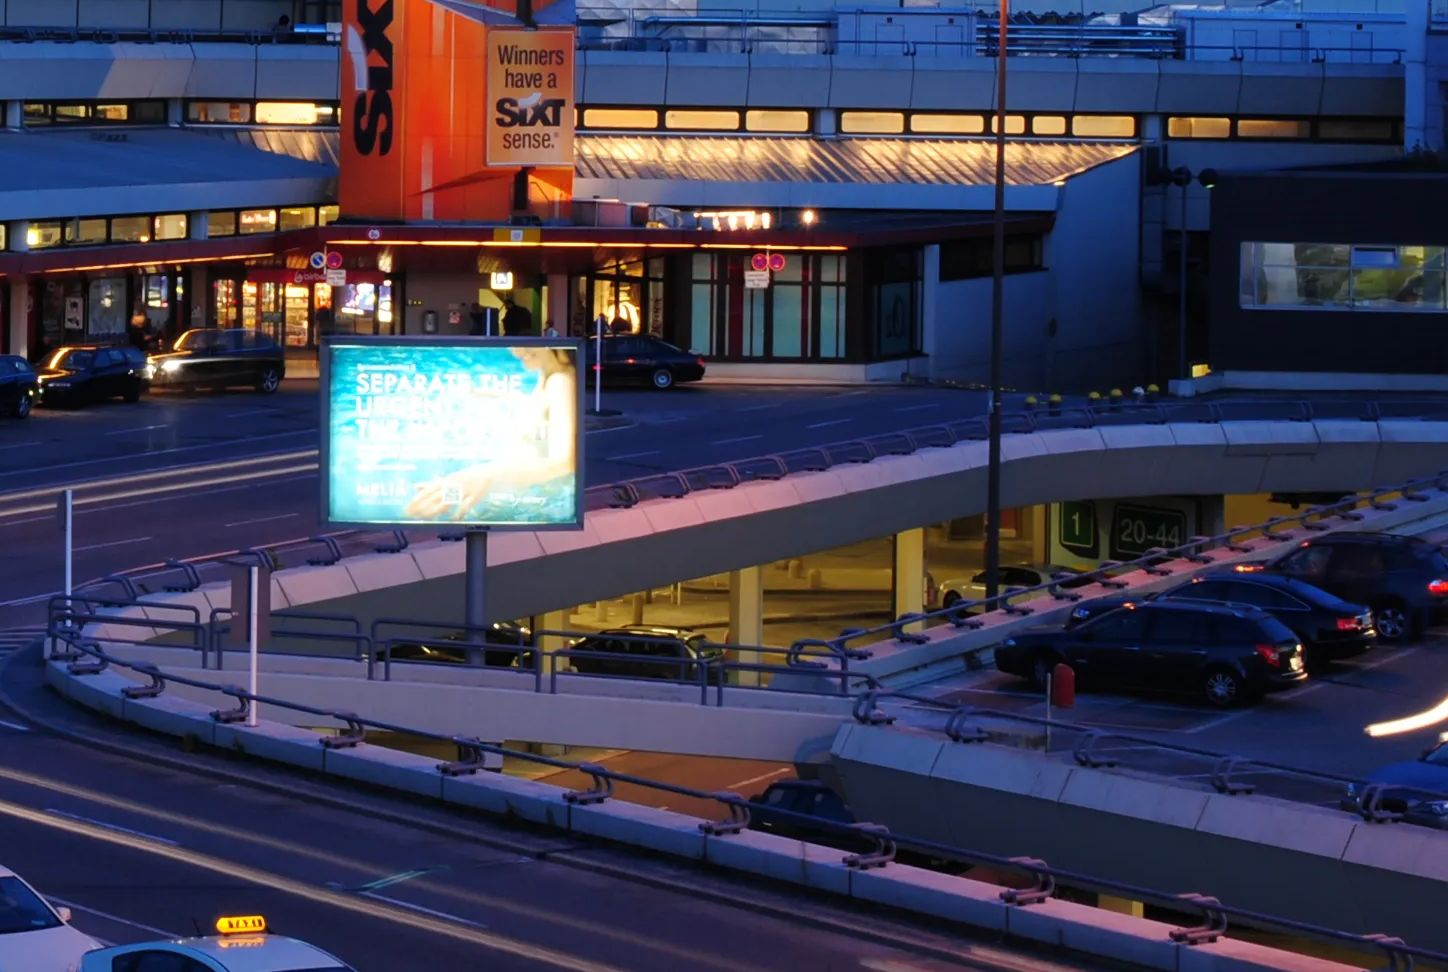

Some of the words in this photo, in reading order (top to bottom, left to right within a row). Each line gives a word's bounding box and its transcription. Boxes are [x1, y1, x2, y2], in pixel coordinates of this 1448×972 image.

[497, 45, 565, 66] Winners
[504, 68, 543, 89] have
[547, 72, 558, 89] a
[356, 373, 471, 394] SEPARATE
[477, 373, 523, 394] THE
[1071, 511, 1080, 537] 1
[1119, 517, 1181, 547] 20-44
[227, 918, 263, 929] TAXI
